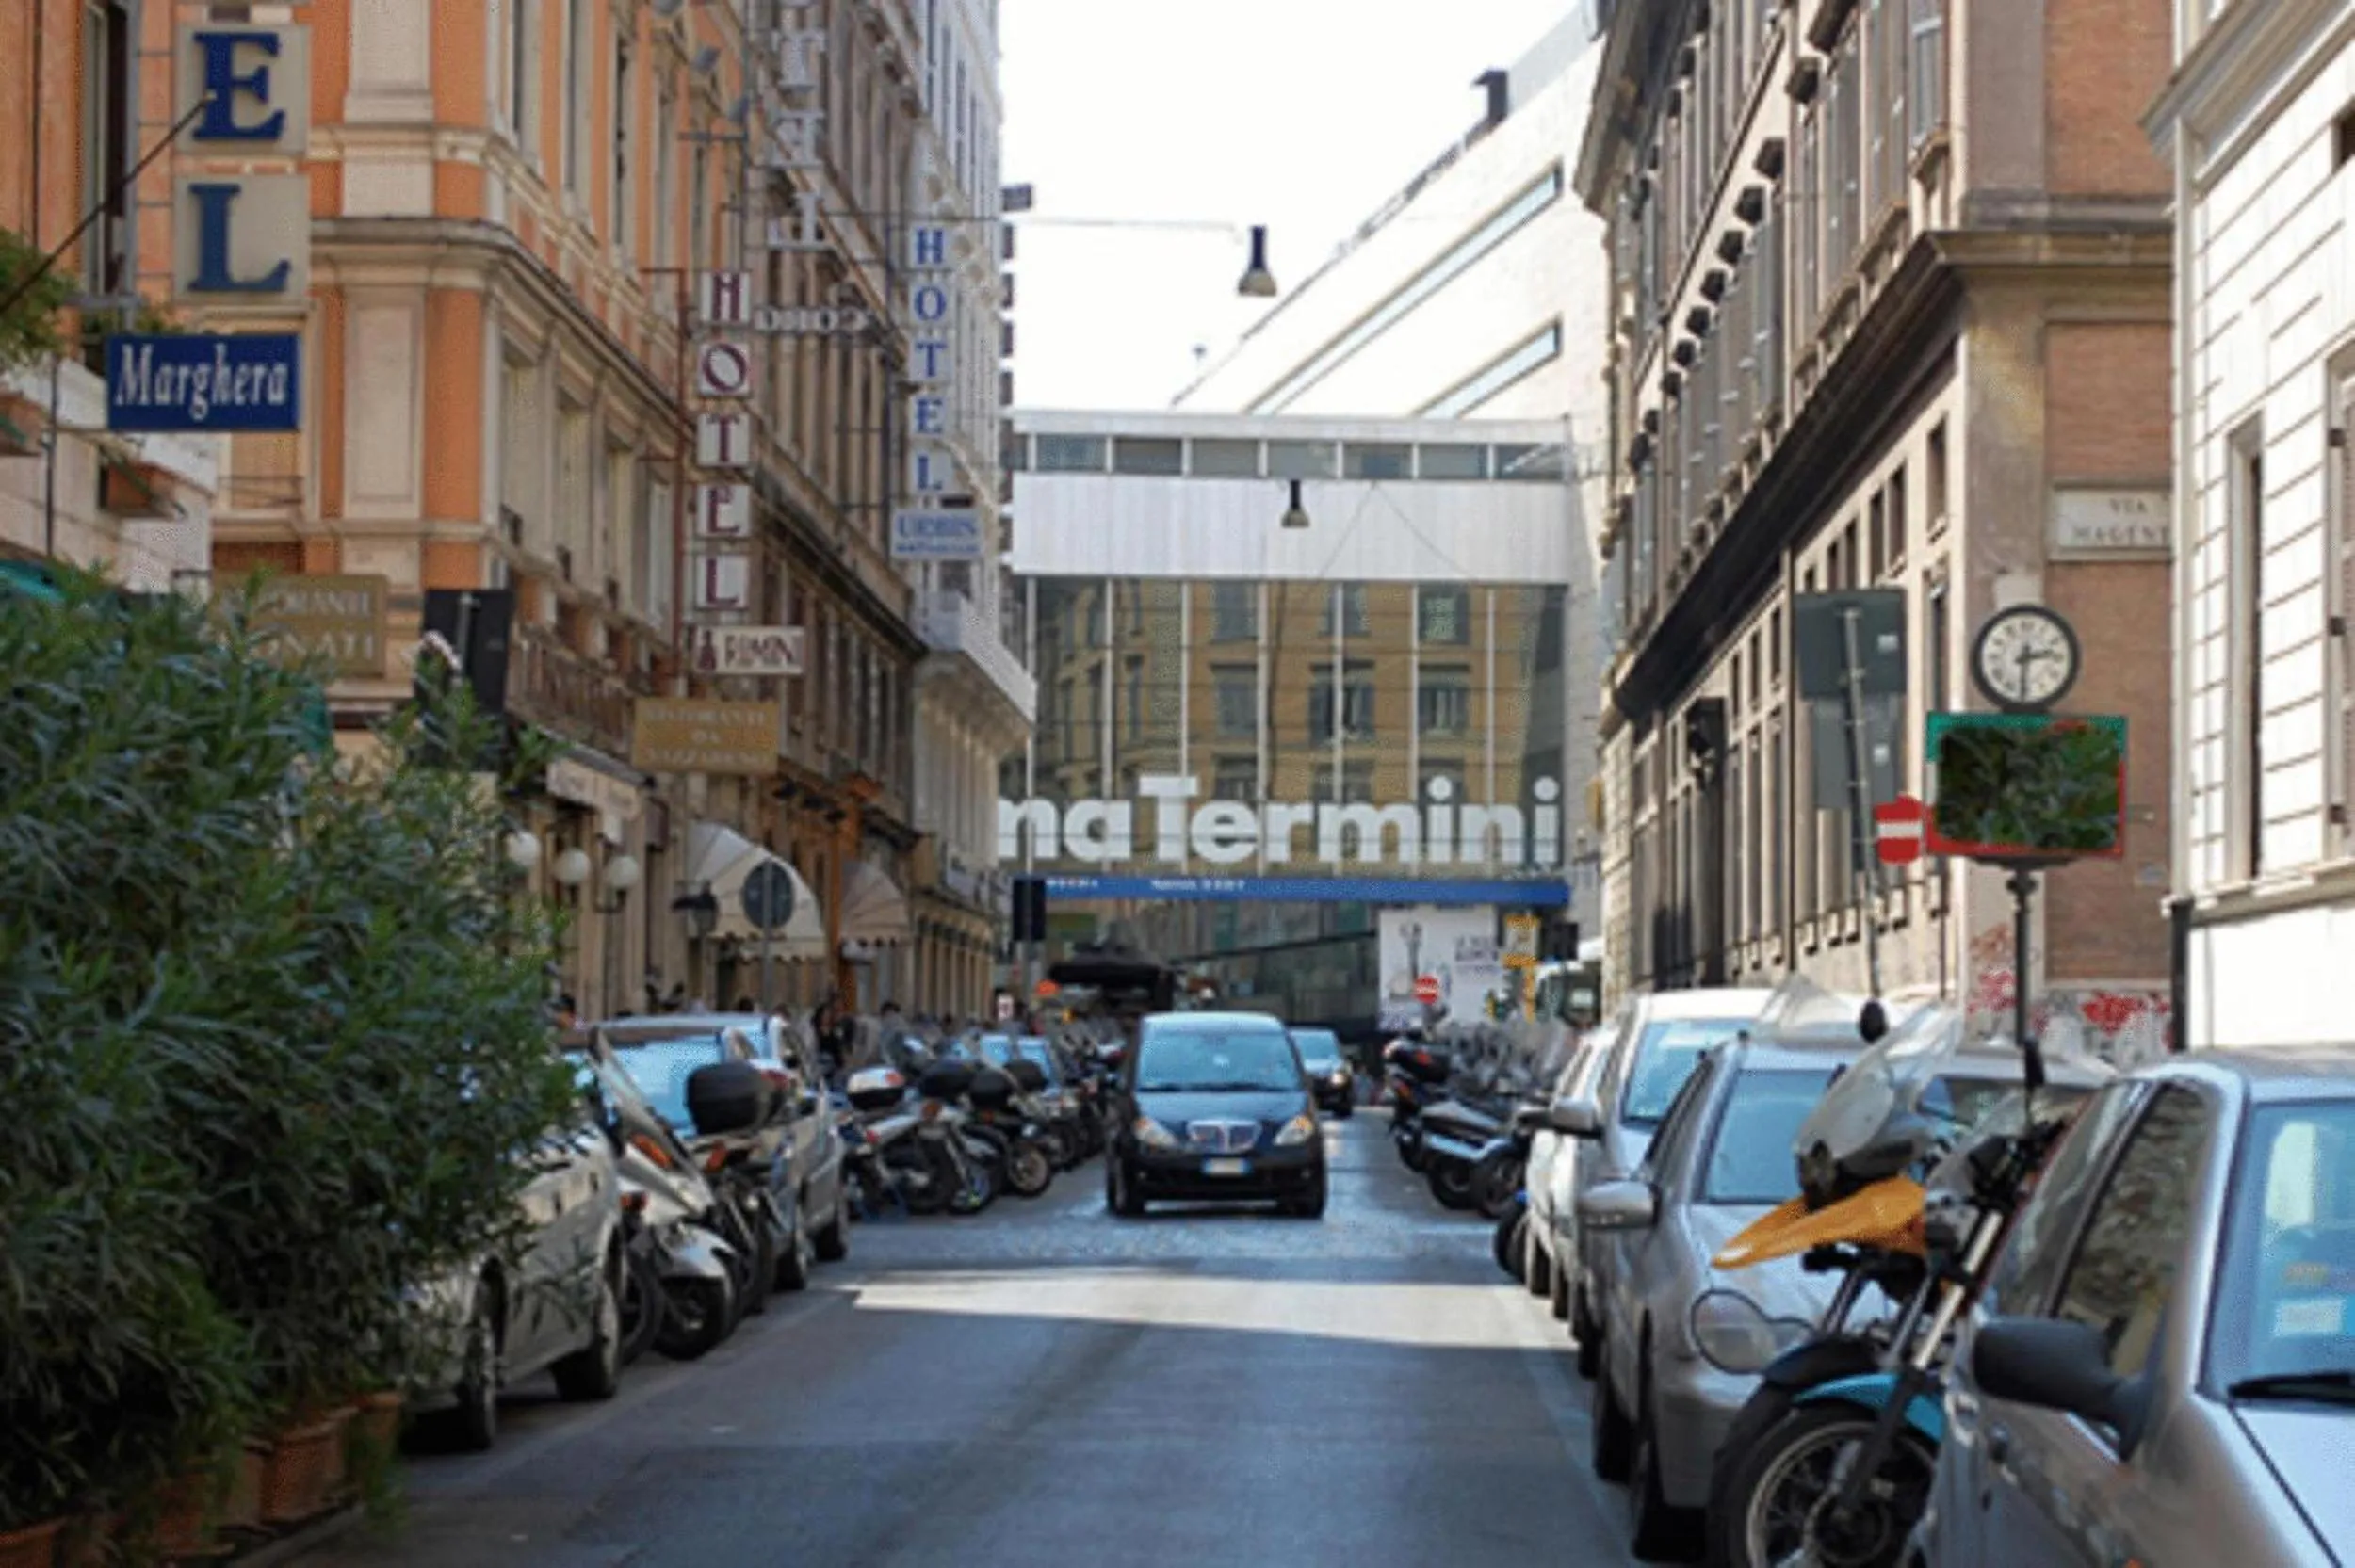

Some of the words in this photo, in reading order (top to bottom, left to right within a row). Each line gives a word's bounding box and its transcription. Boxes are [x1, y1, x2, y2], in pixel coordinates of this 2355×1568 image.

[114, 343, 288, 421] Marghera
[701, 272, 748, 607] HOTEL
[913, 228, 948, 493] HOTEL
[2109, 497, 2148, 513] VIA
